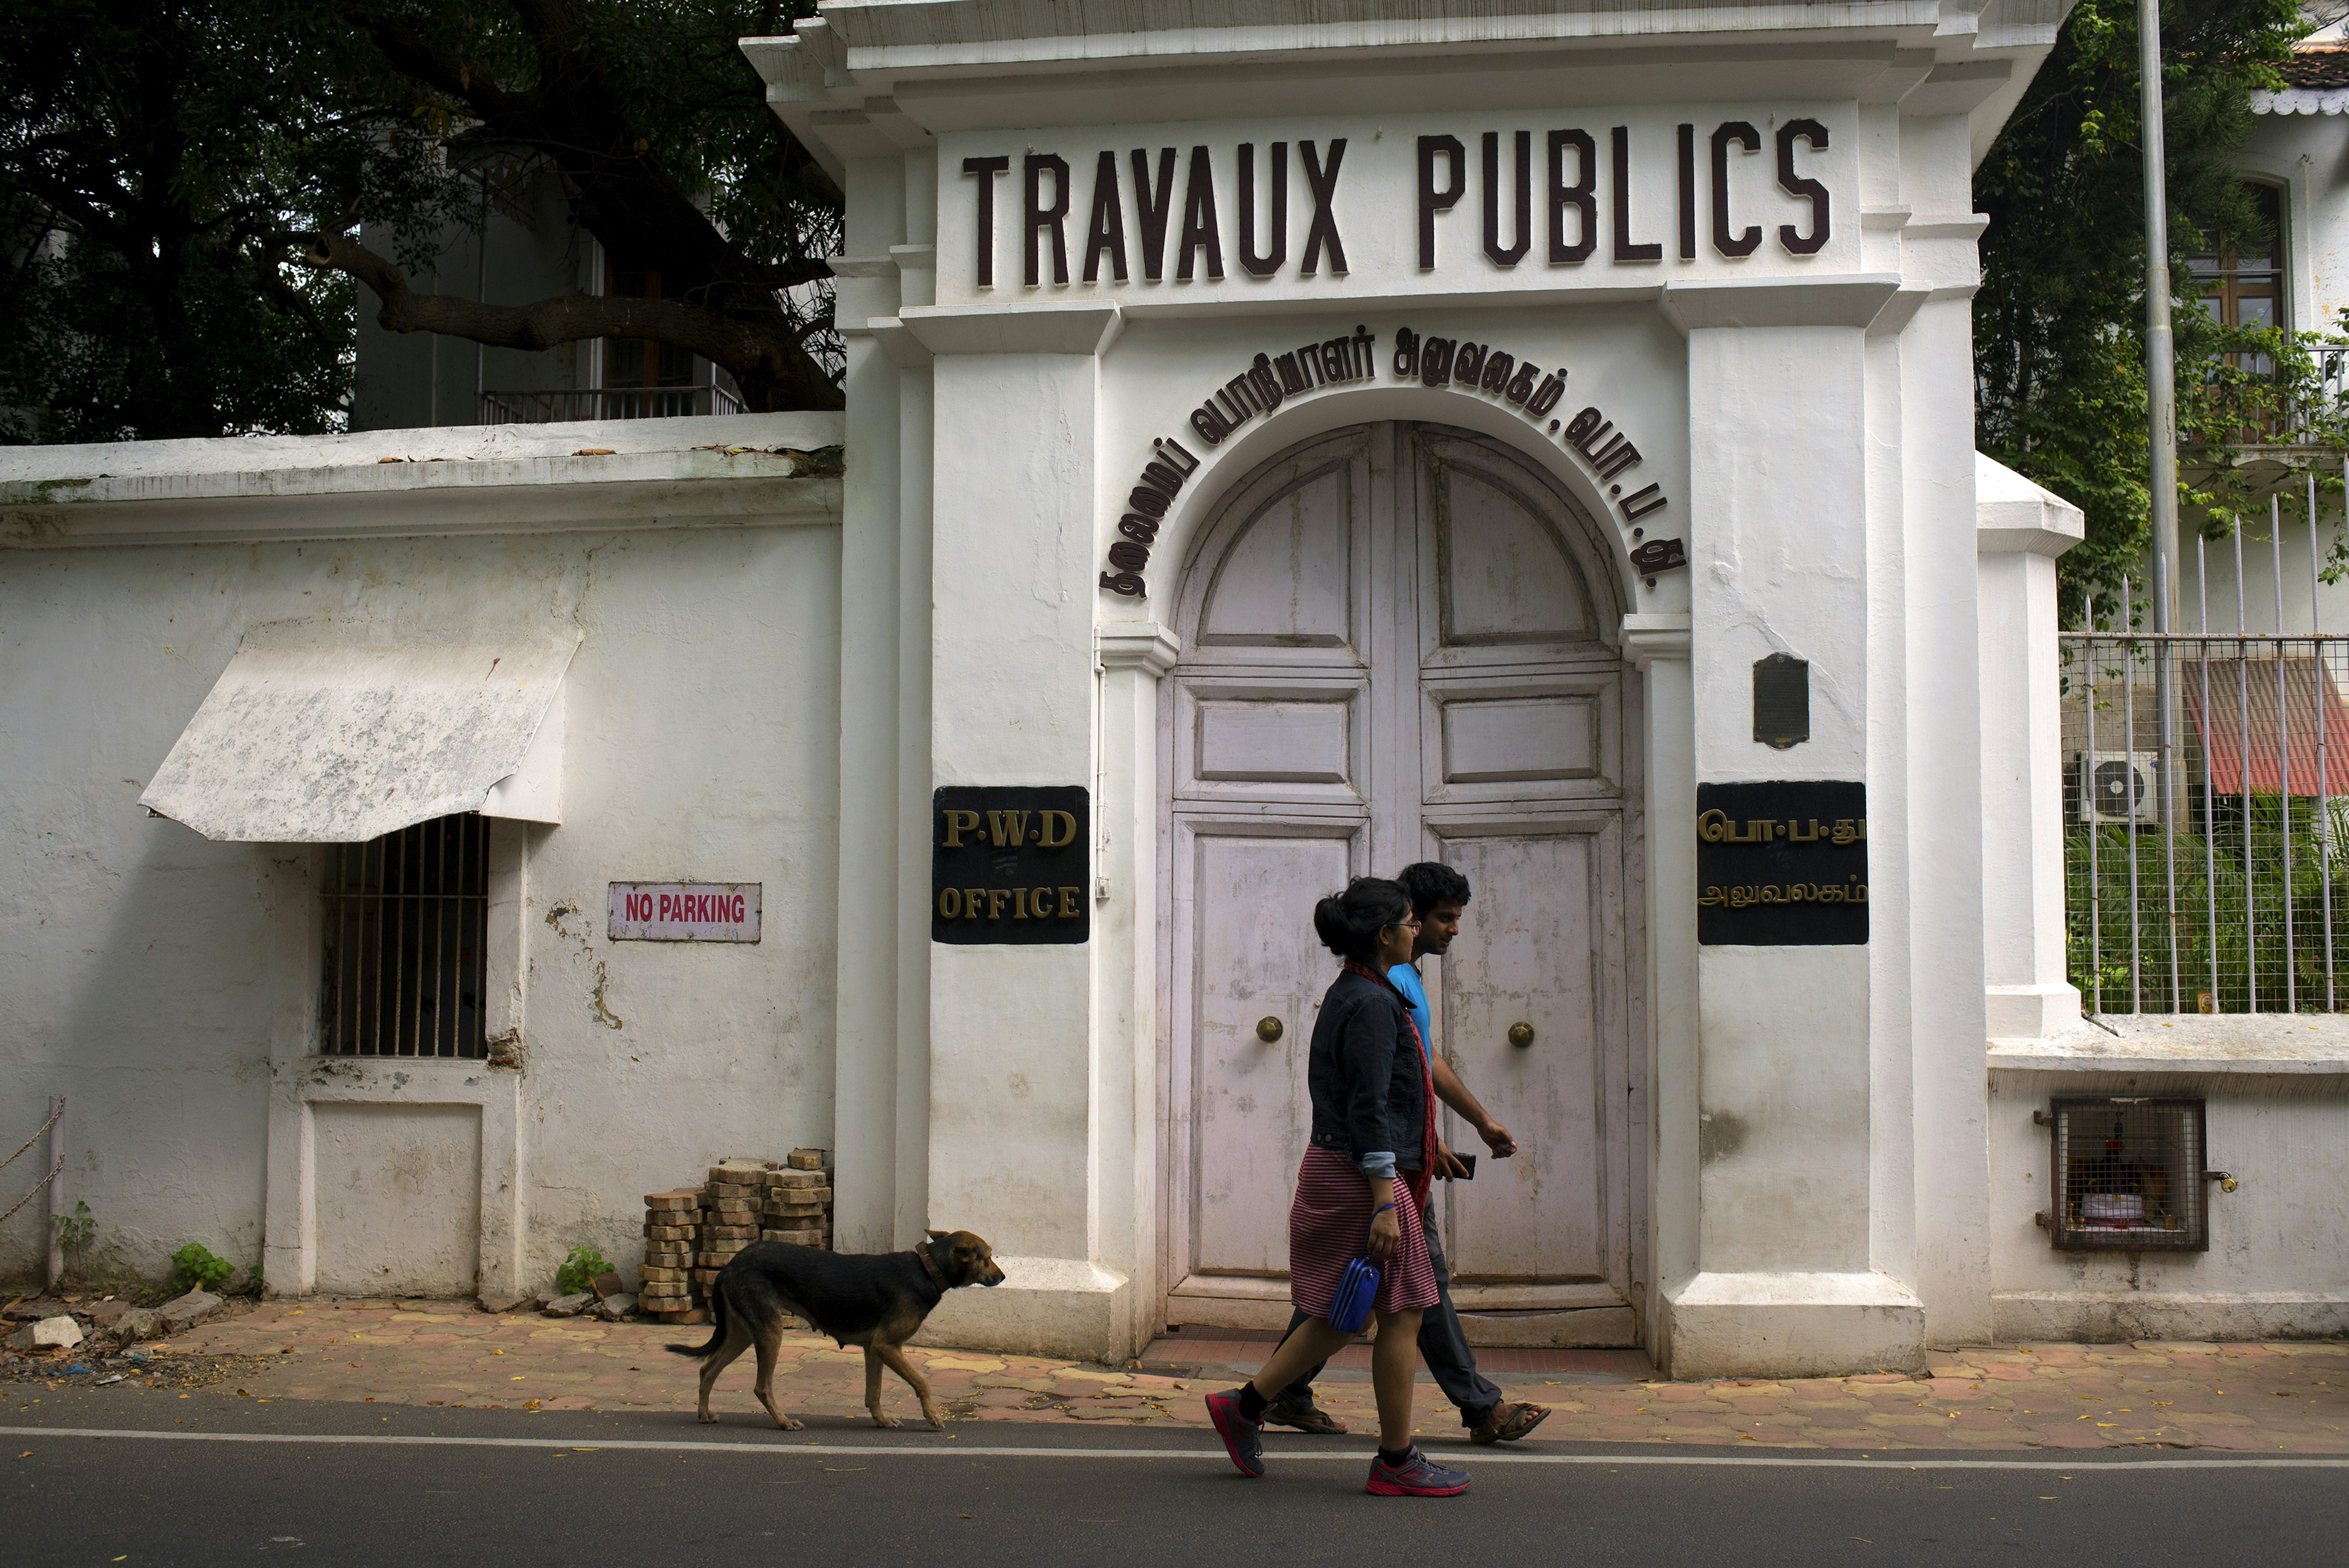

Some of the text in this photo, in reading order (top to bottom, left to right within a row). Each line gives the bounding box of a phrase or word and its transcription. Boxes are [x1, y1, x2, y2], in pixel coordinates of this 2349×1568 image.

[962, 119, 1830, 288] TRAVAUX PUBLICS
[1099, 437, 1201, 599] தலைமைப்
[1190, 324, 1376, 445] பொறியாளர்
[625, 893, 745, 923] NO PARKING
[938, 886, 1081, 920] OFFICE
[1697, 874, 1869, 908] அலுவலகம்
